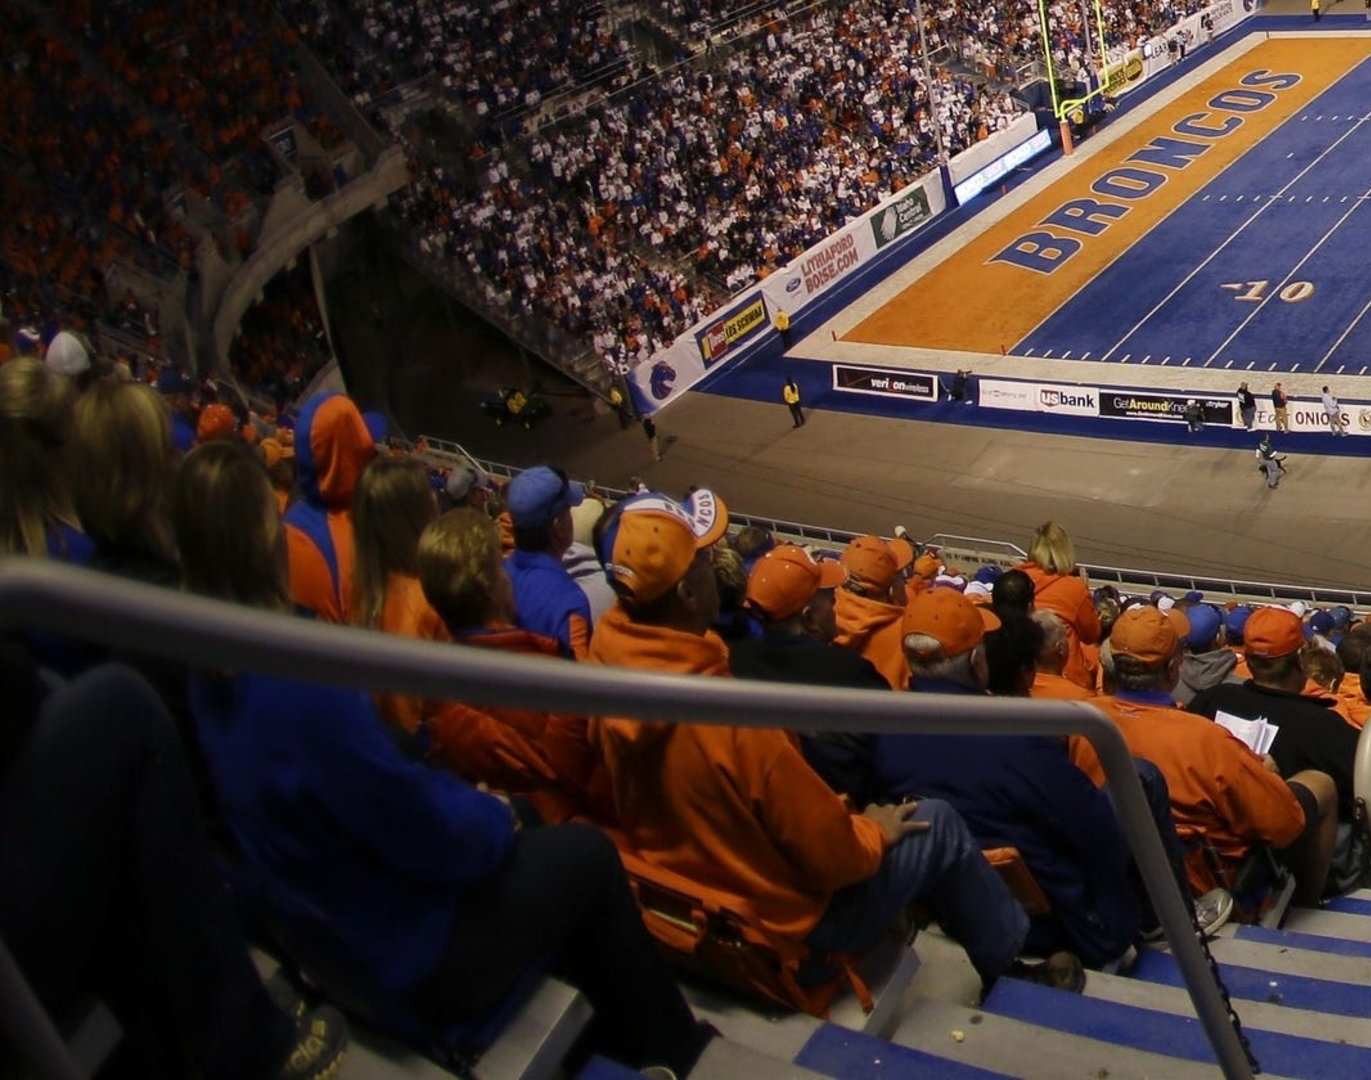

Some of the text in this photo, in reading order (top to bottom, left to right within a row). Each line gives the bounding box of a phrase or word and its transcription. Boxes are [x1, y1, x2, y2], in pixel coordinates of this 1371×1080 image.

[983, 68, 1304, 276] BRONCOS
[800, 233, 855, 279] LITHIAFORD
[805, 247, 860, 295] BOISE.COM
[1234, 280, 1316, 304] 10
[725, 322, 738, 339] LES
[1295, 411, 1351, 427] ONIOS
